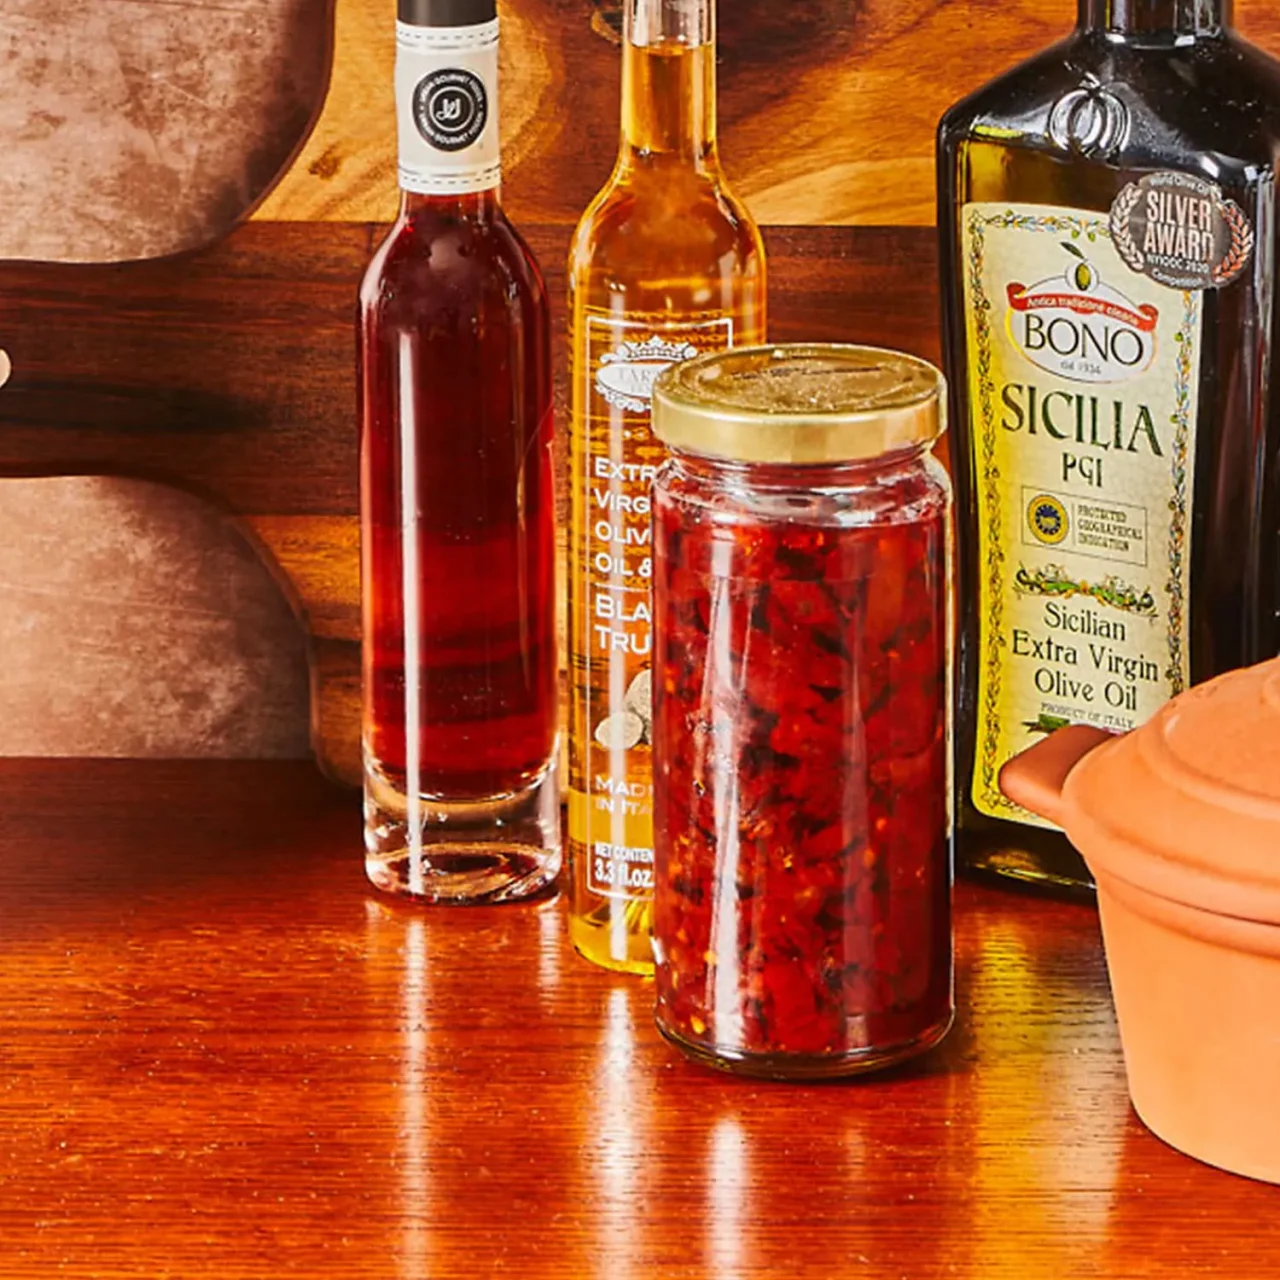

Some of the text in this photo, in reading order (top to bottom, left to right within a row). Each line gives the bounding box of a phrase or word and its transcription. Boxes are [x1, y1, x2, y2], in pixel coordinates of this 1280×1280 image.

[1146, 190, 1212, 232] SILVER
[1143, 221, 1216, 262] AWARD
[1024, 313, 1144, 366] BONO
[1001, 384, 1164, 457] SICILIA
[1062, 452, 1103, 488] PGI
[594, 487, 652, 514] VIRG
[1078, 504, 1127, 523] PROTECTED
[595, 520, 653, 546] OLIV
[1078, 518, 1143, 540] GEOGRAPHICAL
[1078, 532, 1129, 551] INDICATION
[595, 552, 653, 578] OIL &
[596, 593, 652, 623] BLA
[1043, 601, 1126, 642] Sicilian
[594, 624, 652, 655] TRU
[1012, 628, 1159, 682] Extra Virgin
[1034, 667, 1137, 711] Olive Oil
[1040, 702, 1135, 728] PRODUCT OF ITALY
[595, 795, 652, 816] IN ITA
[594, 857, 615, 885] 3.3
